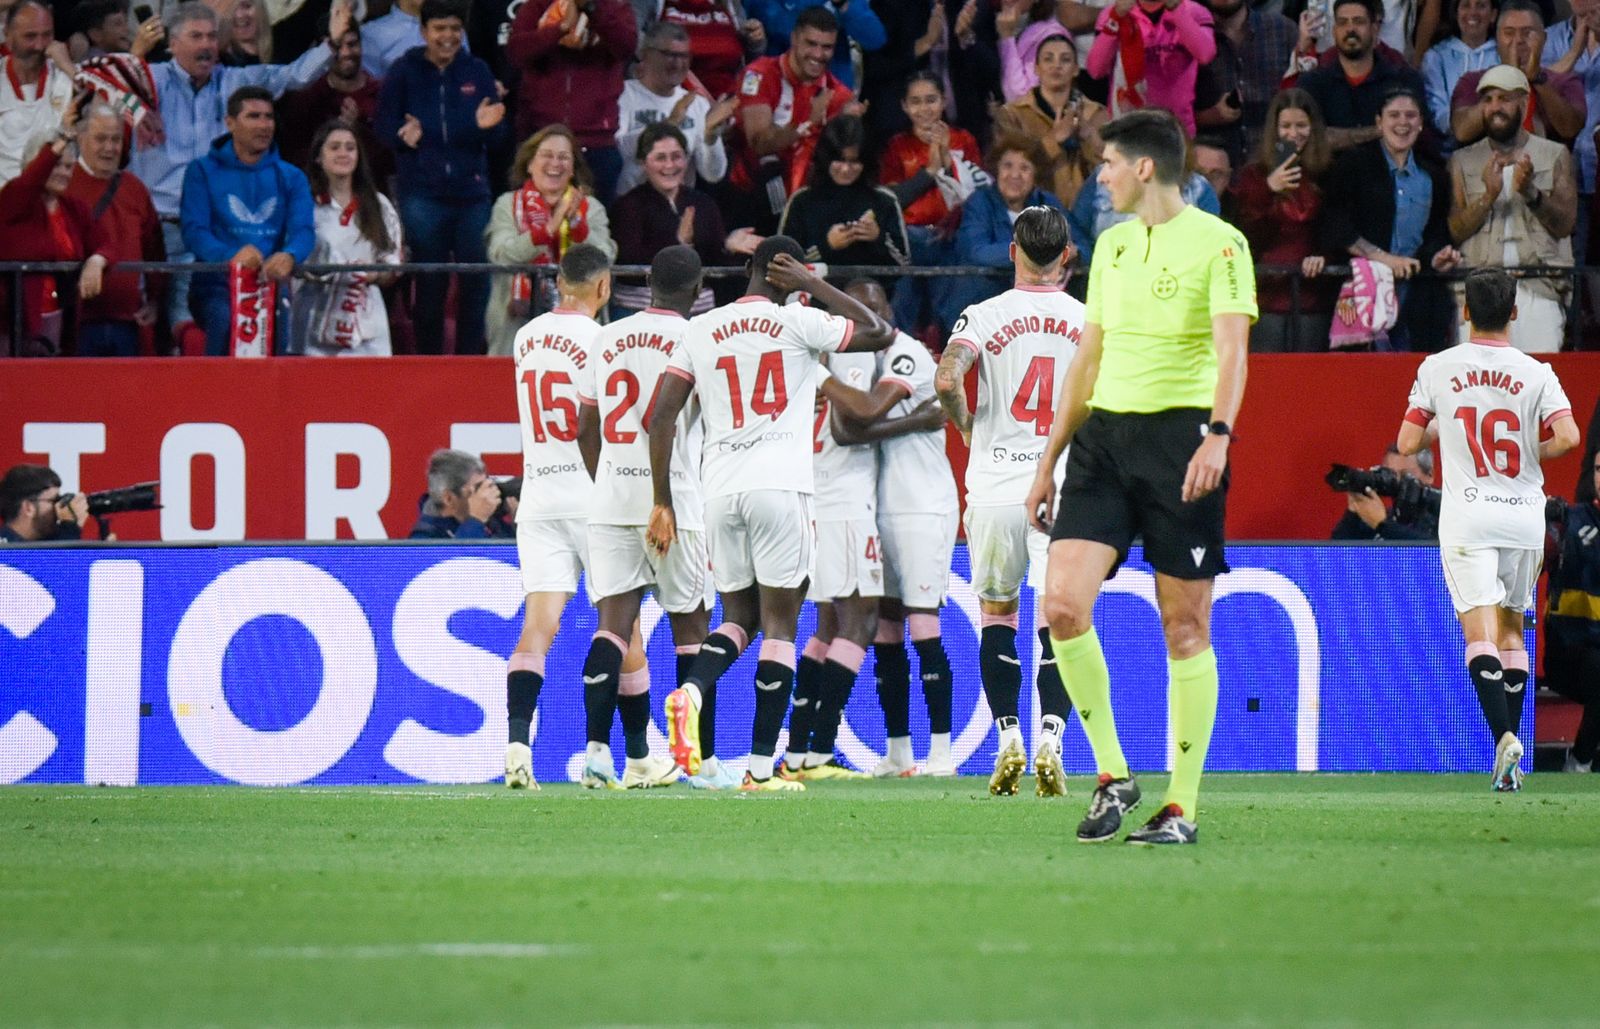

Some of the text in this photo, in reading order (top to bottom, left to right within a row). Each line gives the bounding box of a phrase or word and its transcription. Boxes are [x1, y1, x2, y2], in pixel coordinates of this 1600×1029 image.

[602, 332, 675, 364] B.SOUMA
[711, 317, 784, 345] NIANZOU
[985, 315, 1040, 356] SERGIO
[1043, 317, 1083, 347] RAM
[520, 369, 579, 443] 15
[603, 368, 655, 444] 2
[715, 350, 788, 430] 14
[1010, 355, 1055, 437] 4
[1450, 370, 1524, 396] J.NAVAS
[1454, 406, 1521, 479] 16
